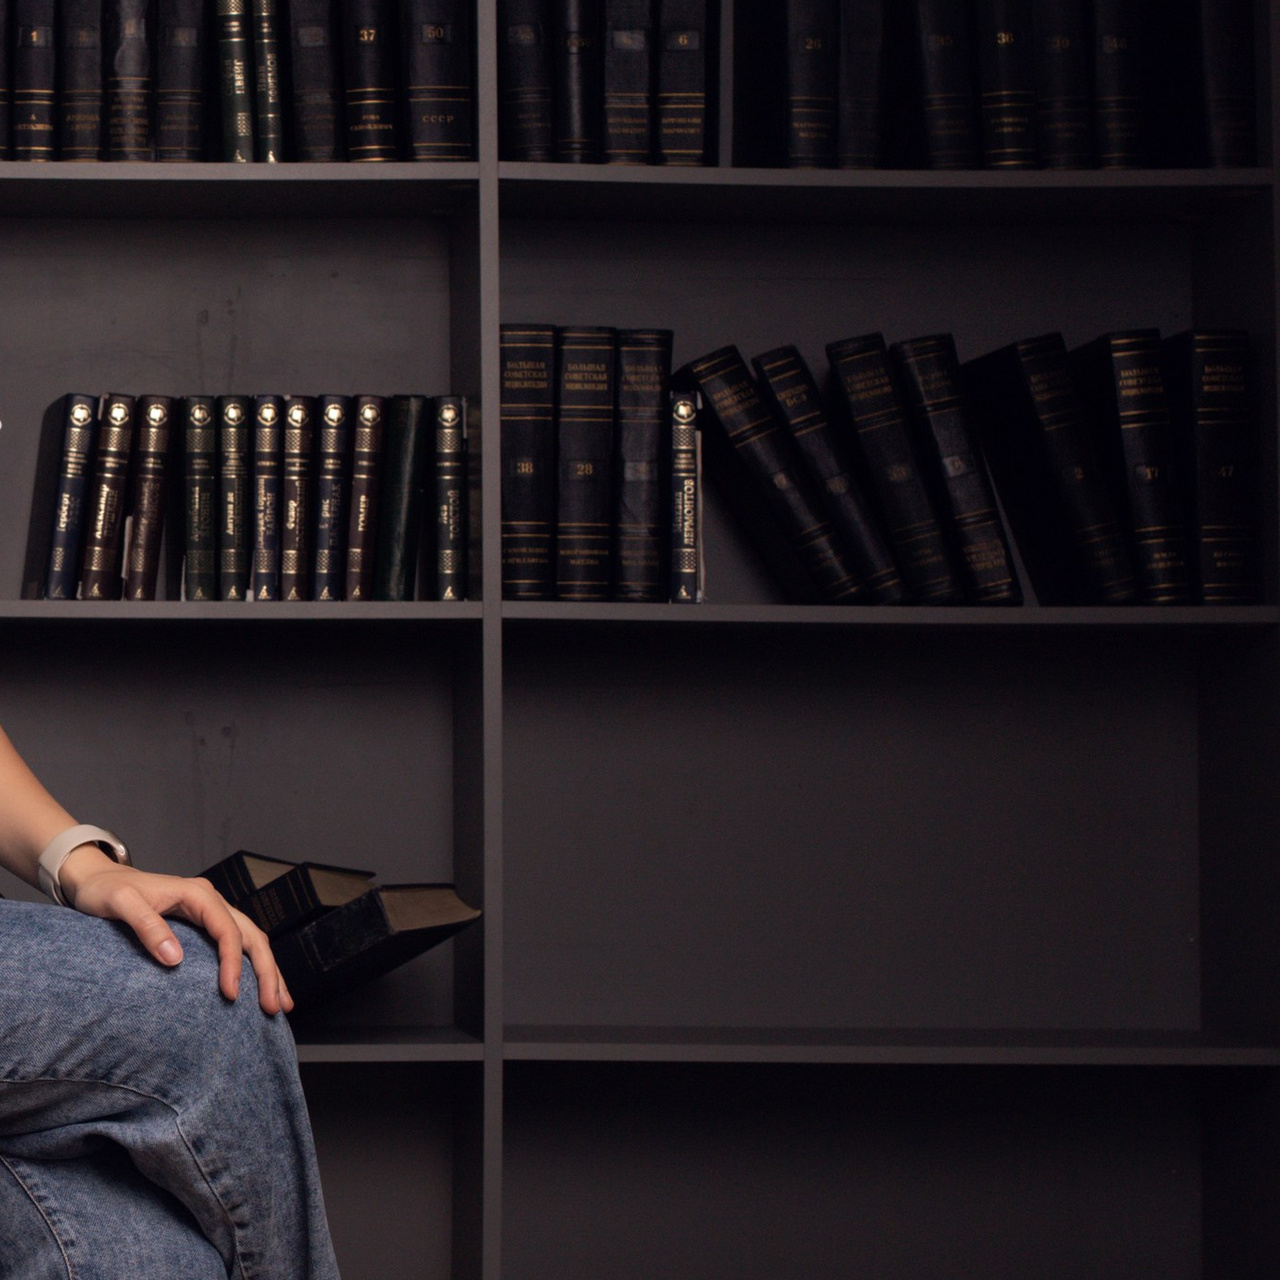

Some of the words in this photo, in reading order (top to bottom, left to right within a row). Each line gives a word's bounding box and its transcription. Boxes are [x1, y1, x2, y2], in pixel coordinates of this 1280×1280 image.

[30, 30, 39, 42] 1
[359, 29, 377, 42] 37
[422, 114, 455, 124] СССР
[516, 462, 534, 475] 38
[576, 463, 594, 476] 28
[683, 478, 695, 546] ЛЕРМОНТОВ
